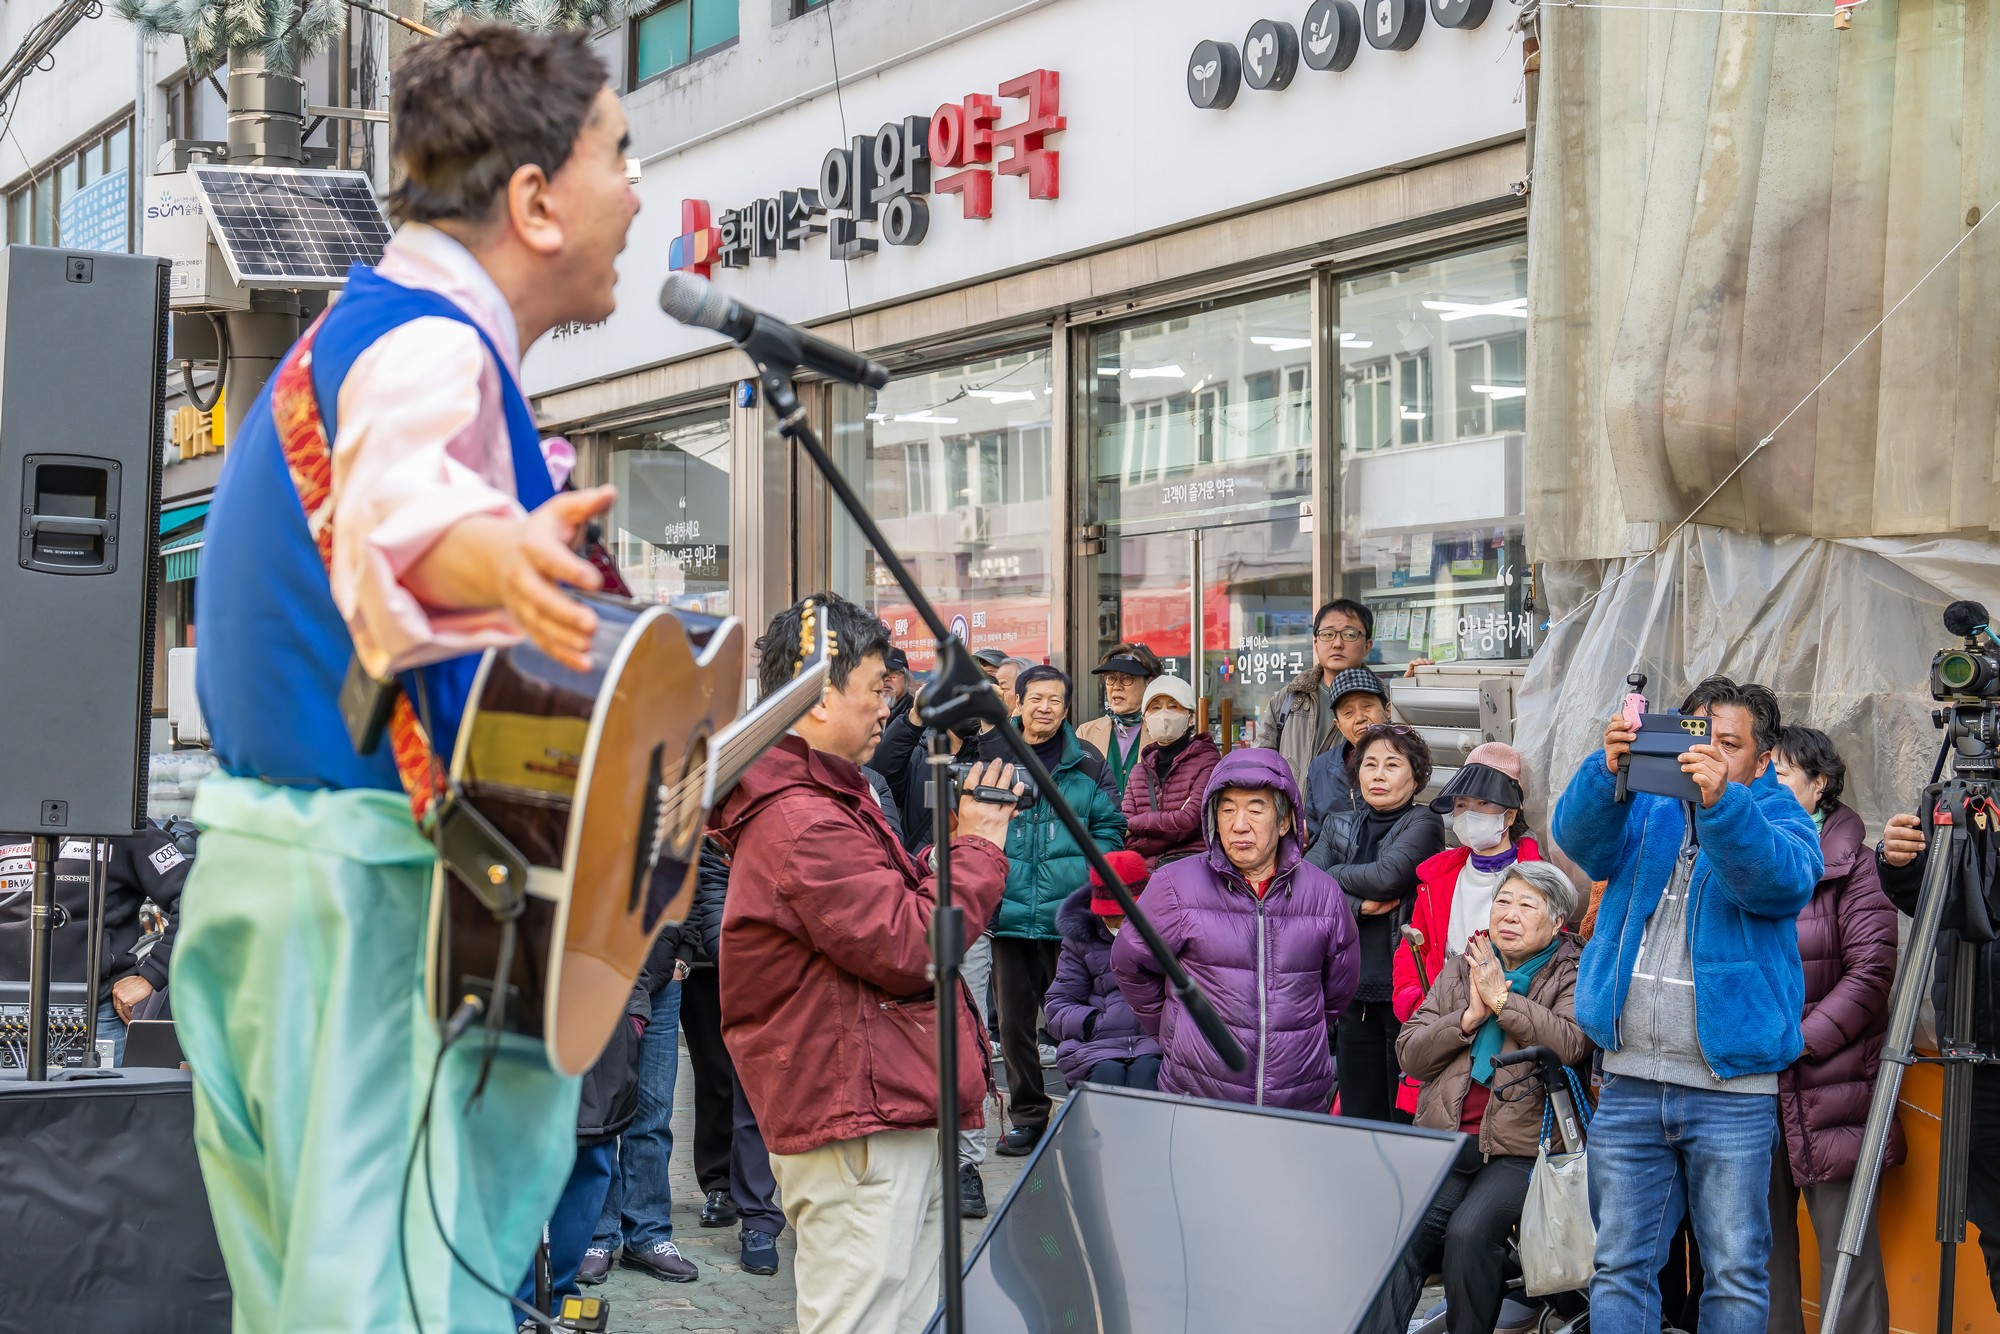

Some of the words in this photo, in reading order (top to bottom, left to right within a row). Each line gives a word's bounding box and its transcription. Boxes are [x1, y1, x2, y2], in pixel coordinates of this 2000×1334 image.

[1162, 484, 1187, 504] 고객이
[1189, 480, 1215, 502] 즐거운
[1216, 478, 1235, 498] 약국
[664, 520, 700, 545] 안녕하세요
[678, 547, 693, 568] 약국
[694, 544, 717, 567] 입니다
[1239, 635, 1269, 651] 휴베이스
[1238, 651, 1304, 685] 인왕약국
[163, 860, 176, 870] Audi
[56, 875, 91, 883] DESCENTE
